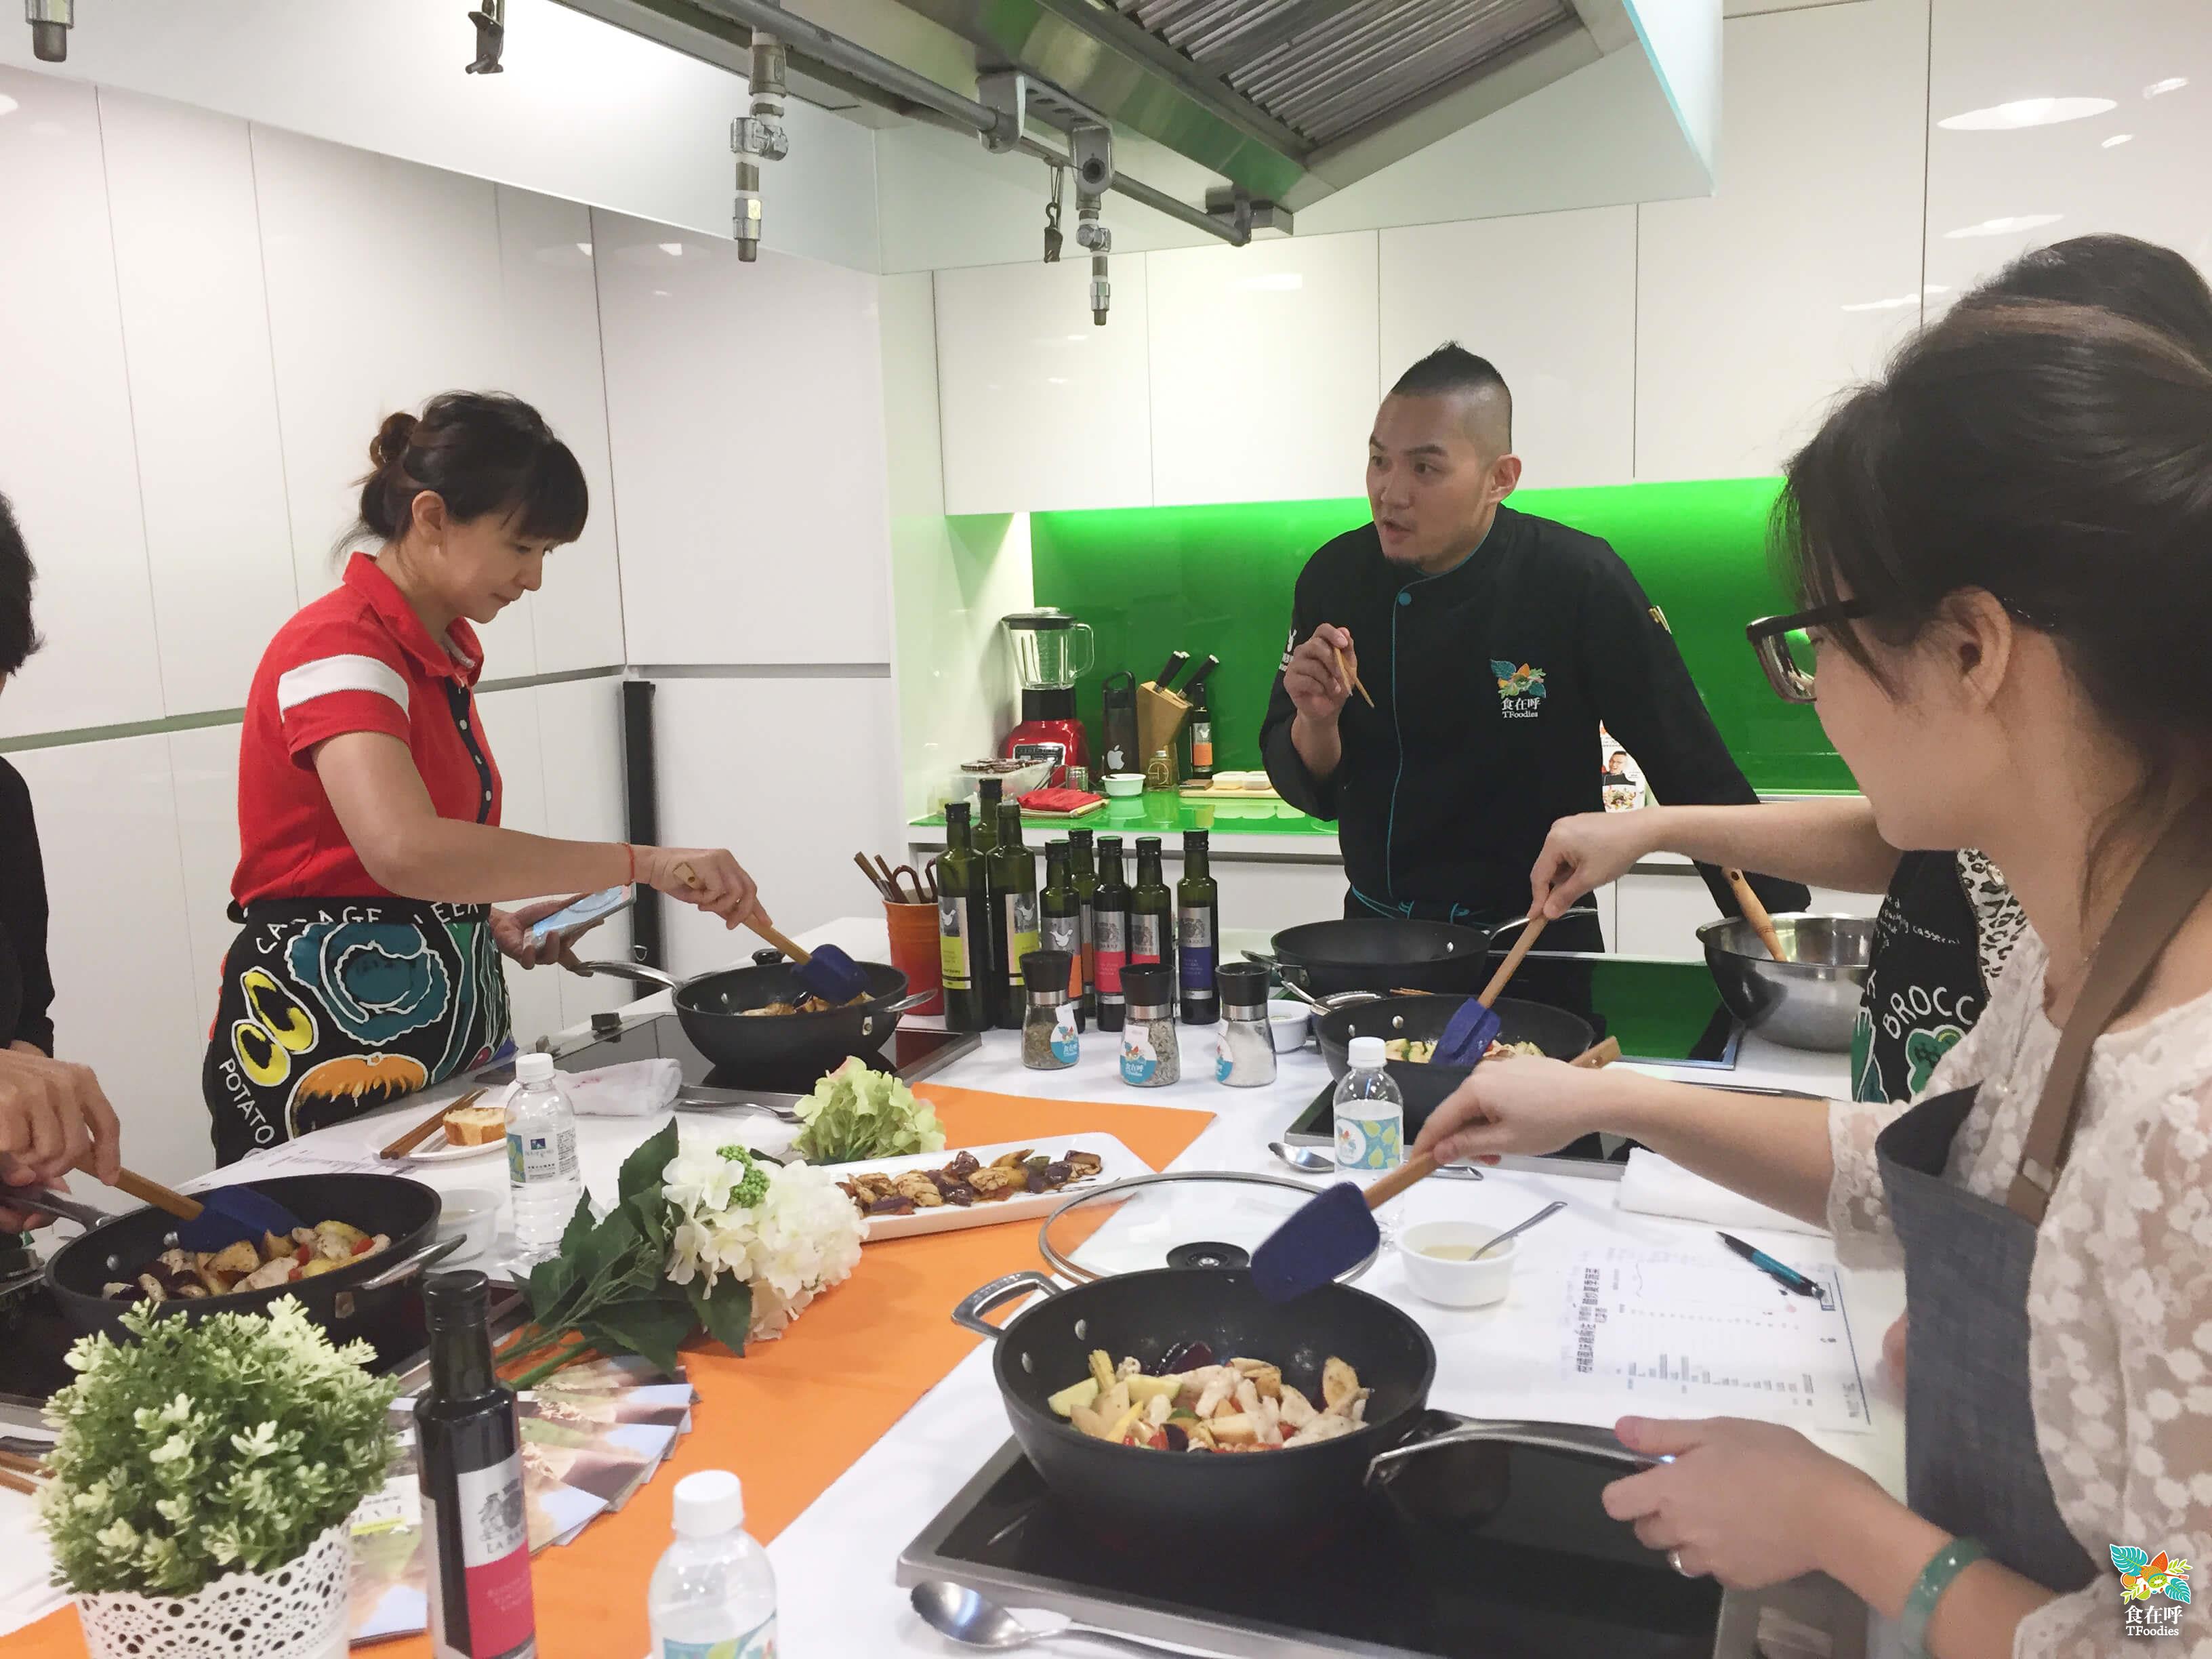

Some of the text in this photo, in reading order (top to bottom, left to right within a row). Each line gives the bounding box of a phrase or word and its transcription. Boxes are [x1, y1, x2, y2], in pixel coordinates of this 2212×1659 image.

[1501, 697, 1540, 710] 食在呼
[256, 907, 382, 954] CAAGE
[219, 1058, 275, 1143] POTATO
